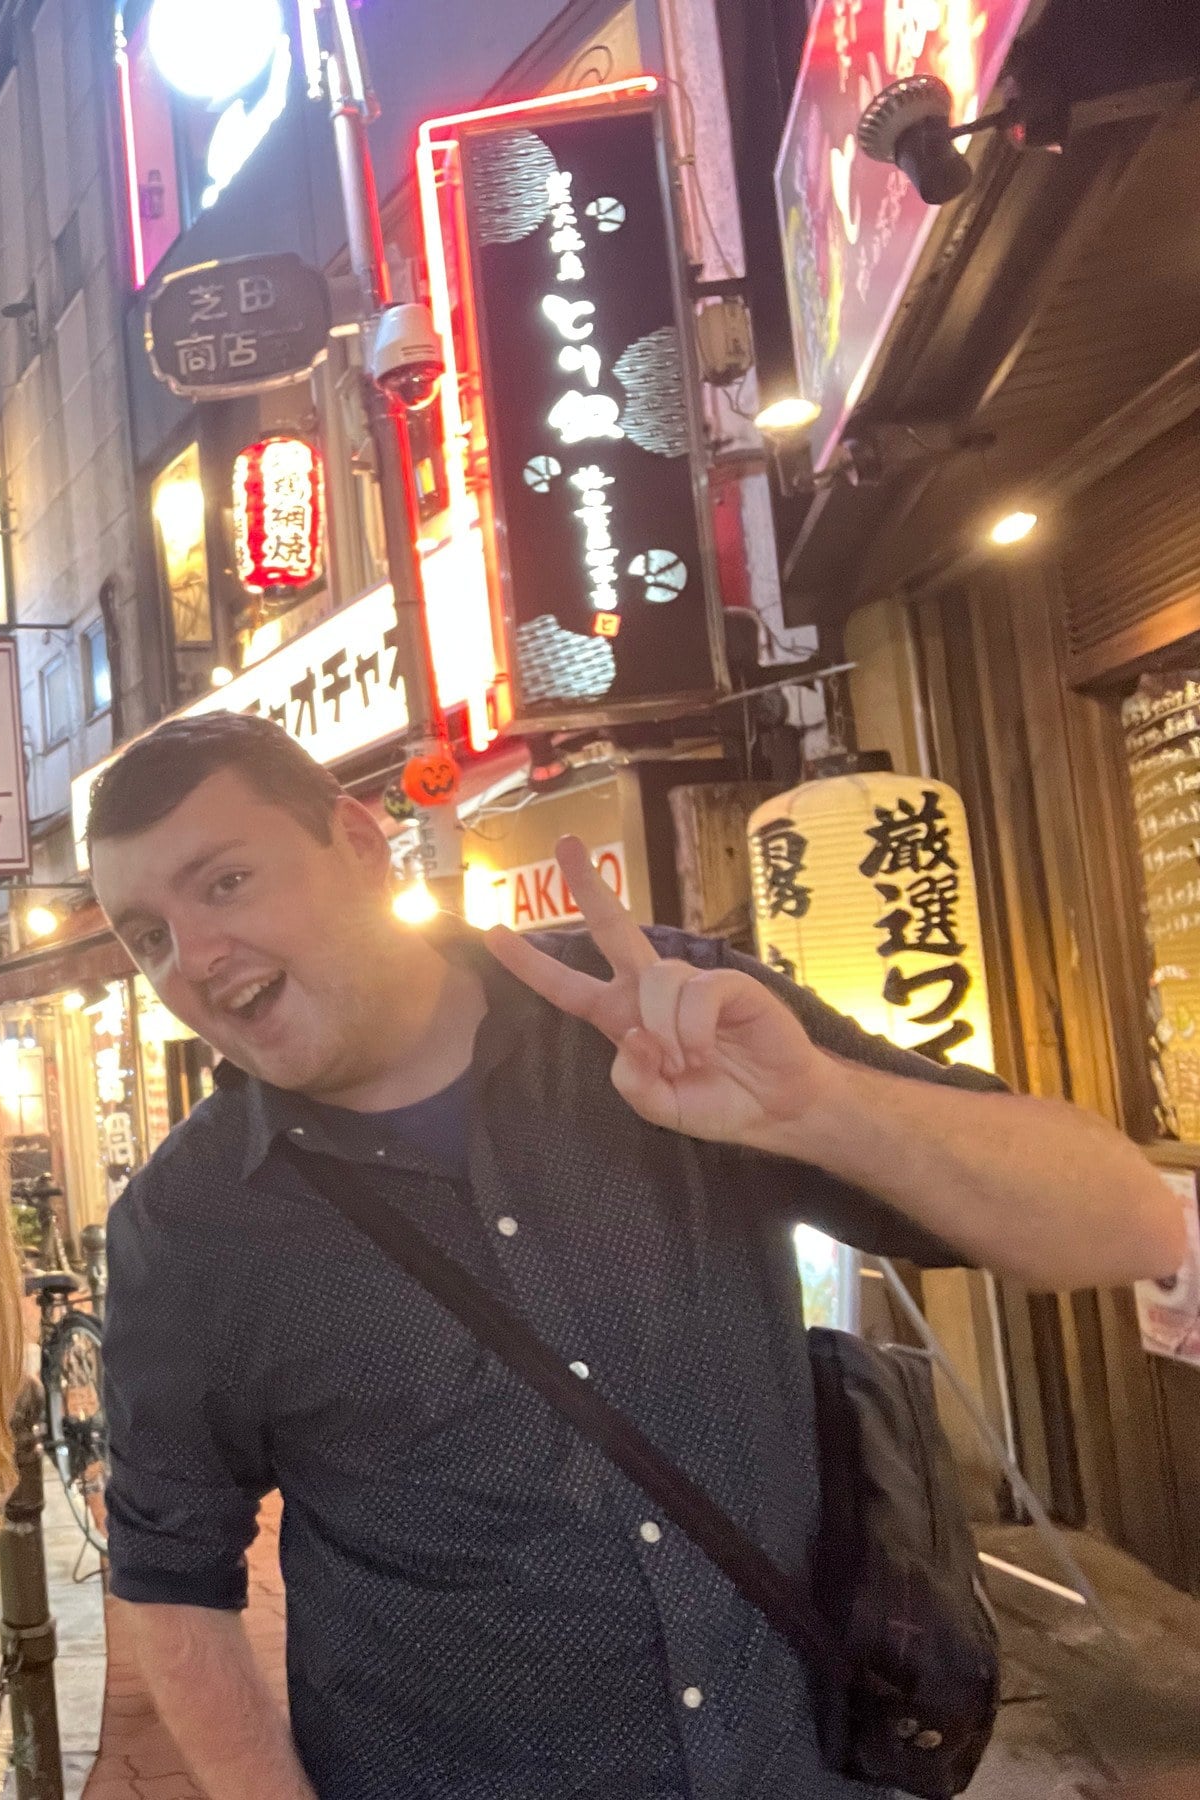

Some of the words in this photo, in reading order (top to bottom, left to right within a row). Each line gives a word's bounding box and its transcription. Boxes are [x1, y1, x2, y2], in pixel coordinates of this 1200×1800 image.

[187, 275, 276, 323] 芝田
[240, 626, 398, 738] ャオチャ
